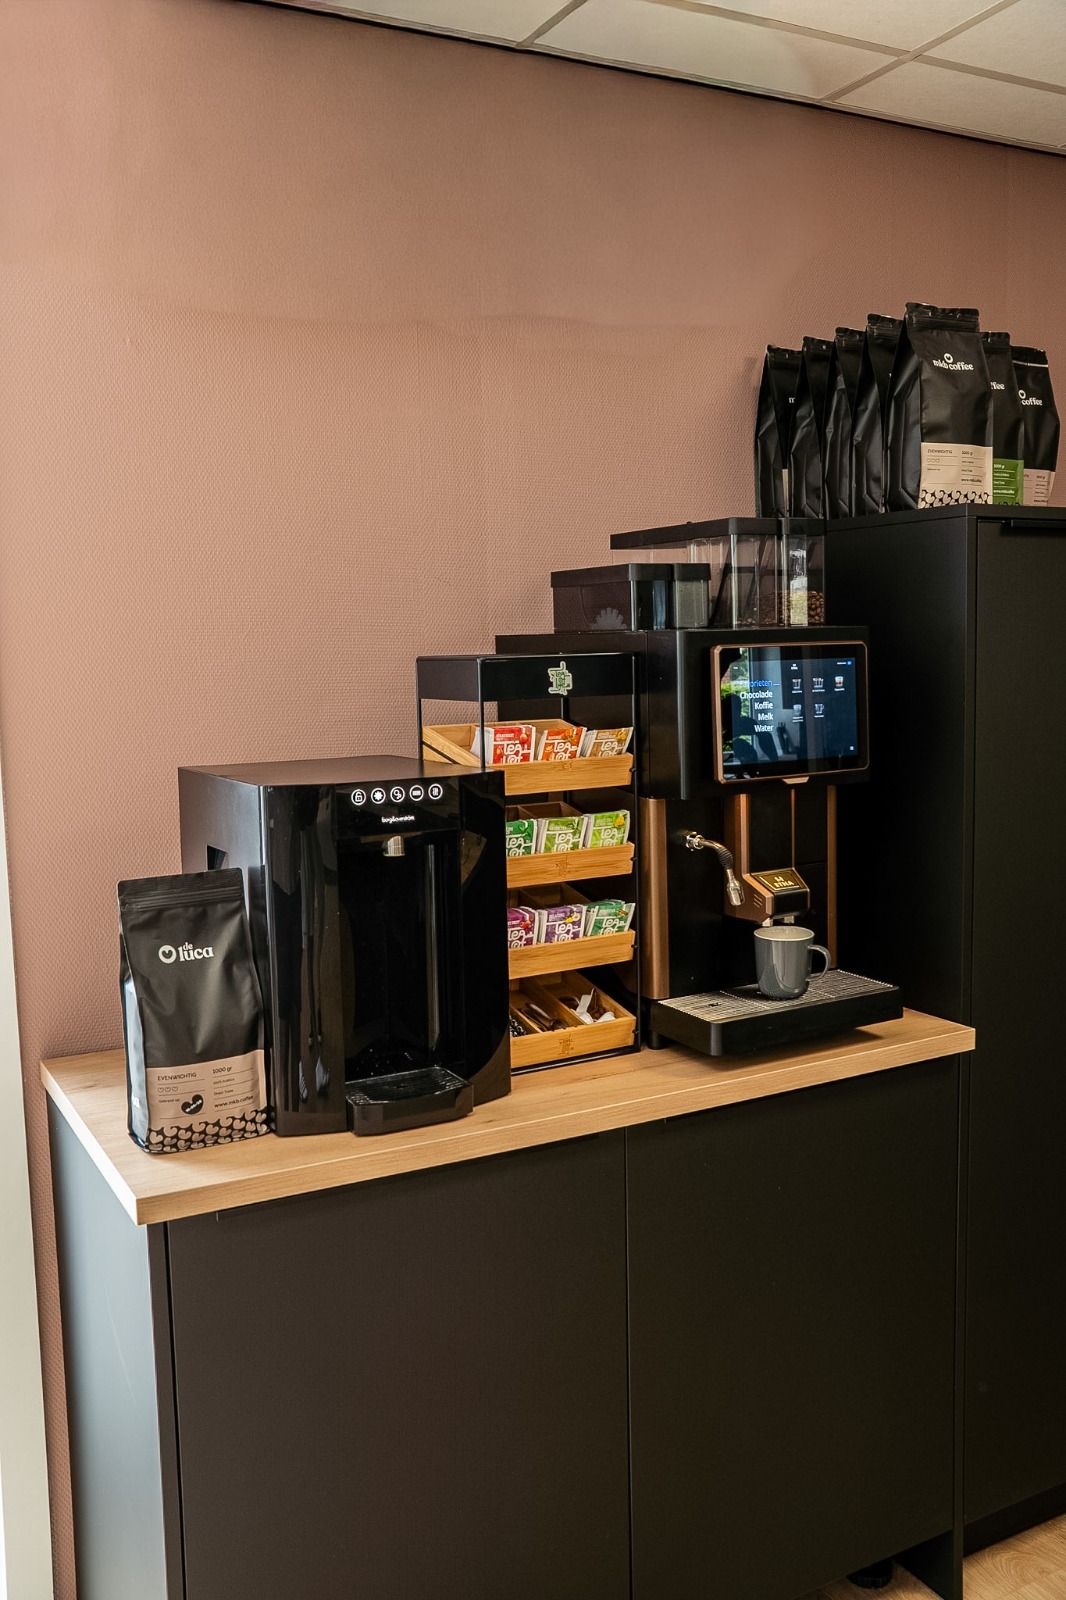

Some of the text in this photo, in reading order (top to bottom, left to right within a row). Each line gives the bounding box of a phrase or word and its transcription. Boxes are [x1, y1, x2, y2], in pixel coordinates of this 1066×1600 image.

[933, 360, 974, 371] mkb coffee
[1021, 397, 1043, 406] coffee
[740, 690, 773, 699] Chocolade
[754, 702, 773, 710] Koffie
[754, 724, 774, 732] Water
[182, 942, 193, 950] de
[178, 946, 214, 962] luca
[157, 1072, 197, 1081] EVENWICHTIG
